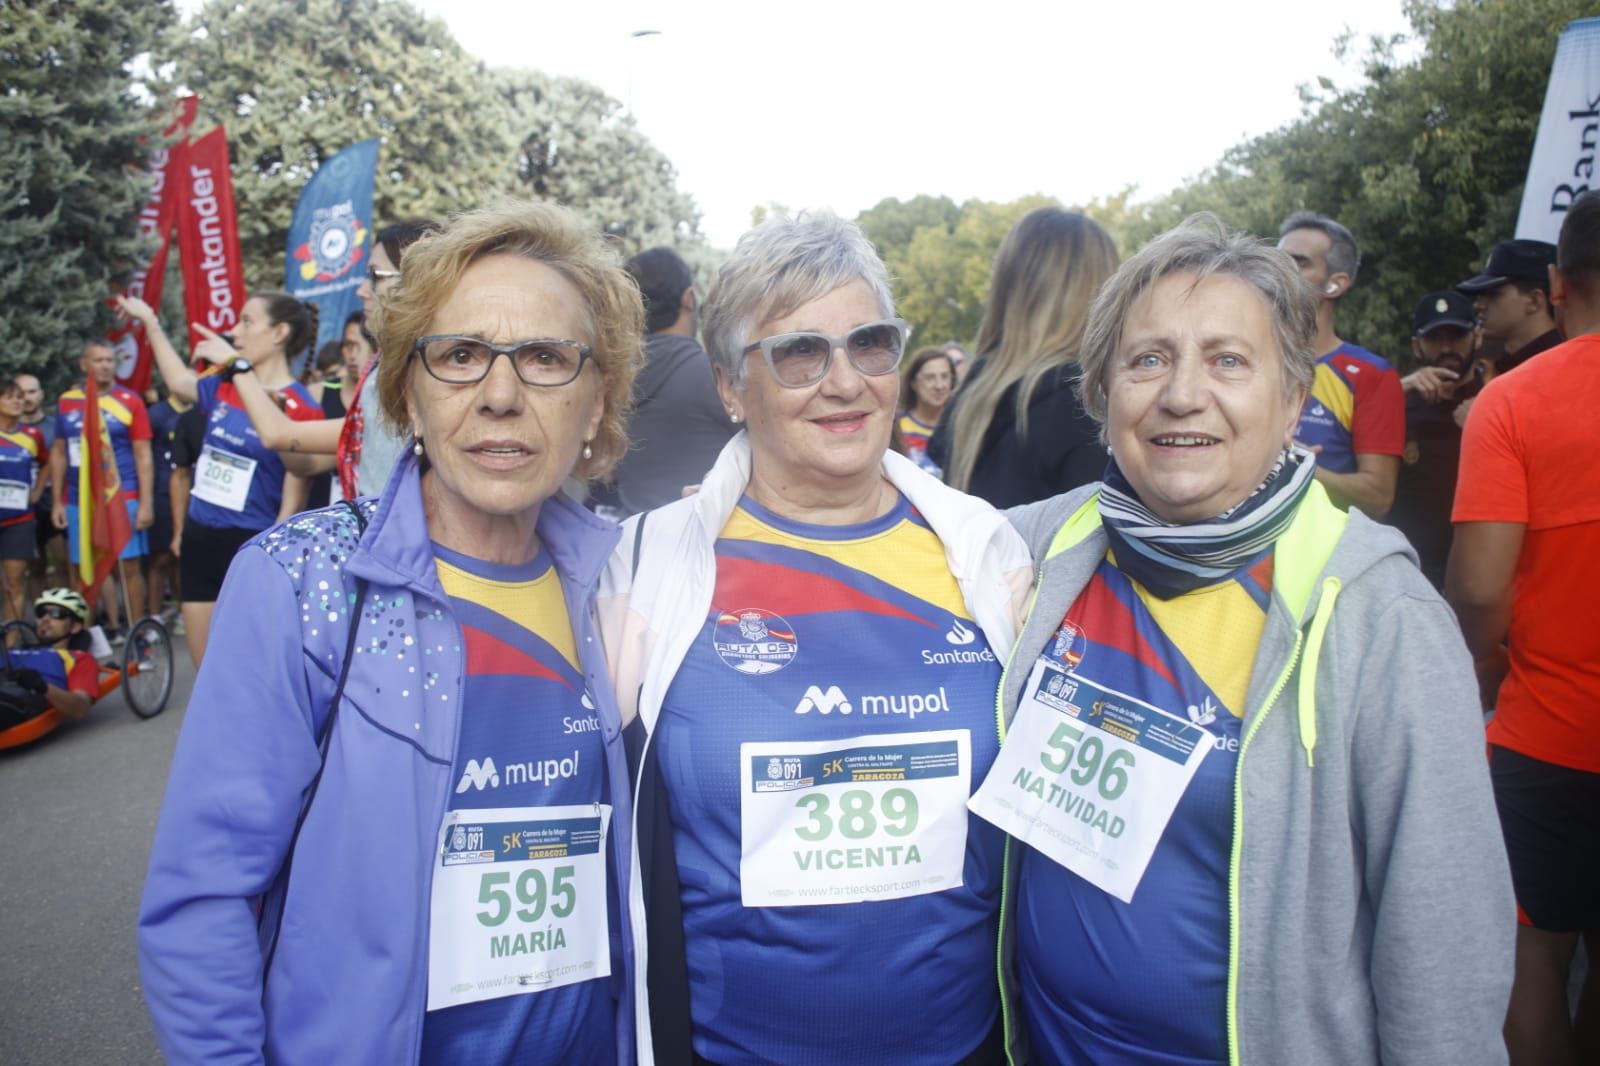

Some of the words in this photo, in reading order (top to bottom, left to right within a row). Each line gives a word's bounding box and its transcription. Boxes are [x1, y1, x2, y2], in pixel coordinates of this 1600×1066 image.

[190, 164, 236, 329] Santander
[203, 461, 234, 485] 206
[717, 642, 761, 653] RUTA
[861, 686, 949, 719] mupol
[505, 750, 580, 787] mupol
[784, 763, 802, 780] 091
[822, 759, 844, 778] 5K
[1040, 721, 1136, 800] 596
[852, 773, 905, 781] ZARAGOZA
[794, 787, 919, 841] 389
[1012, 767, 1126, 839] NATIVIDAD
[467, 832, 484, 850] 091
[502, 832, 522, 852] 5K
[793, 844, 922, 870] VICENTA
[475, 865, 577, 928] 595
[490, 924, 567, 959] MARÍA
